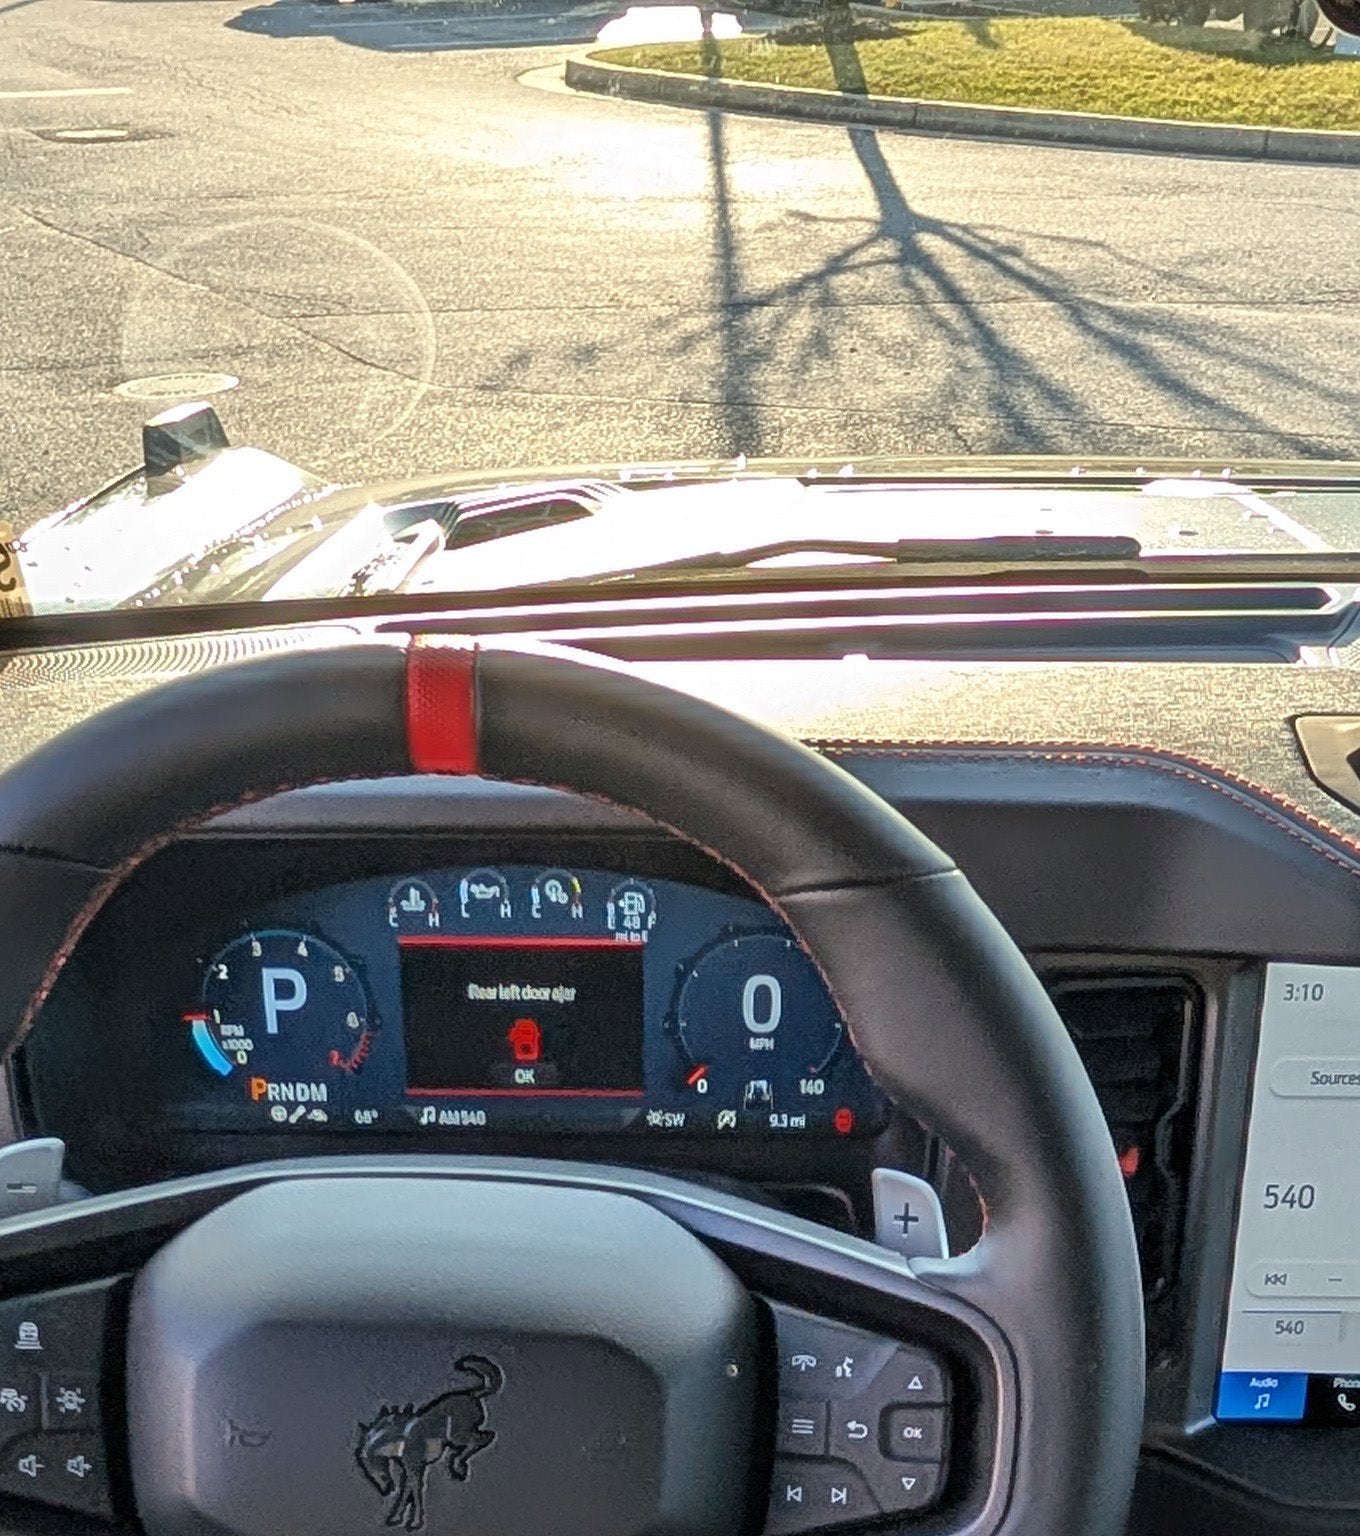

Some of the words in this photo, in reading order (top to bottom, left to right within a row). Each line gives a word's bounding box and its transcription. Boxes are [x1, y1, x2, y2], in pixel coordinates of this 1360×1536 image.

[217, 964, 229, 980] 2
[468, 983, 497, 1000] Rear
[499, 983, 520, 1000] left
[521, 983, 550, 1001] door
[1283, 983, 1324, 1002] 3:10
[262, 967, 307, 1034] P
[742, 974, 782, 1033] 0
[749, 1037, 774, 1051] MPH
[514, 1069, 535, 1084] OK
[696, 1079, 708, 1094] 0
[799, 1079, 825, 1095] 140
[1263, 1184, 1316, 1209] 540
[1274, 1320, 1305, 1335] 540
[1249, 1377, 1279, 1389] Audio
[903, 1426, 923, 1440] OK
